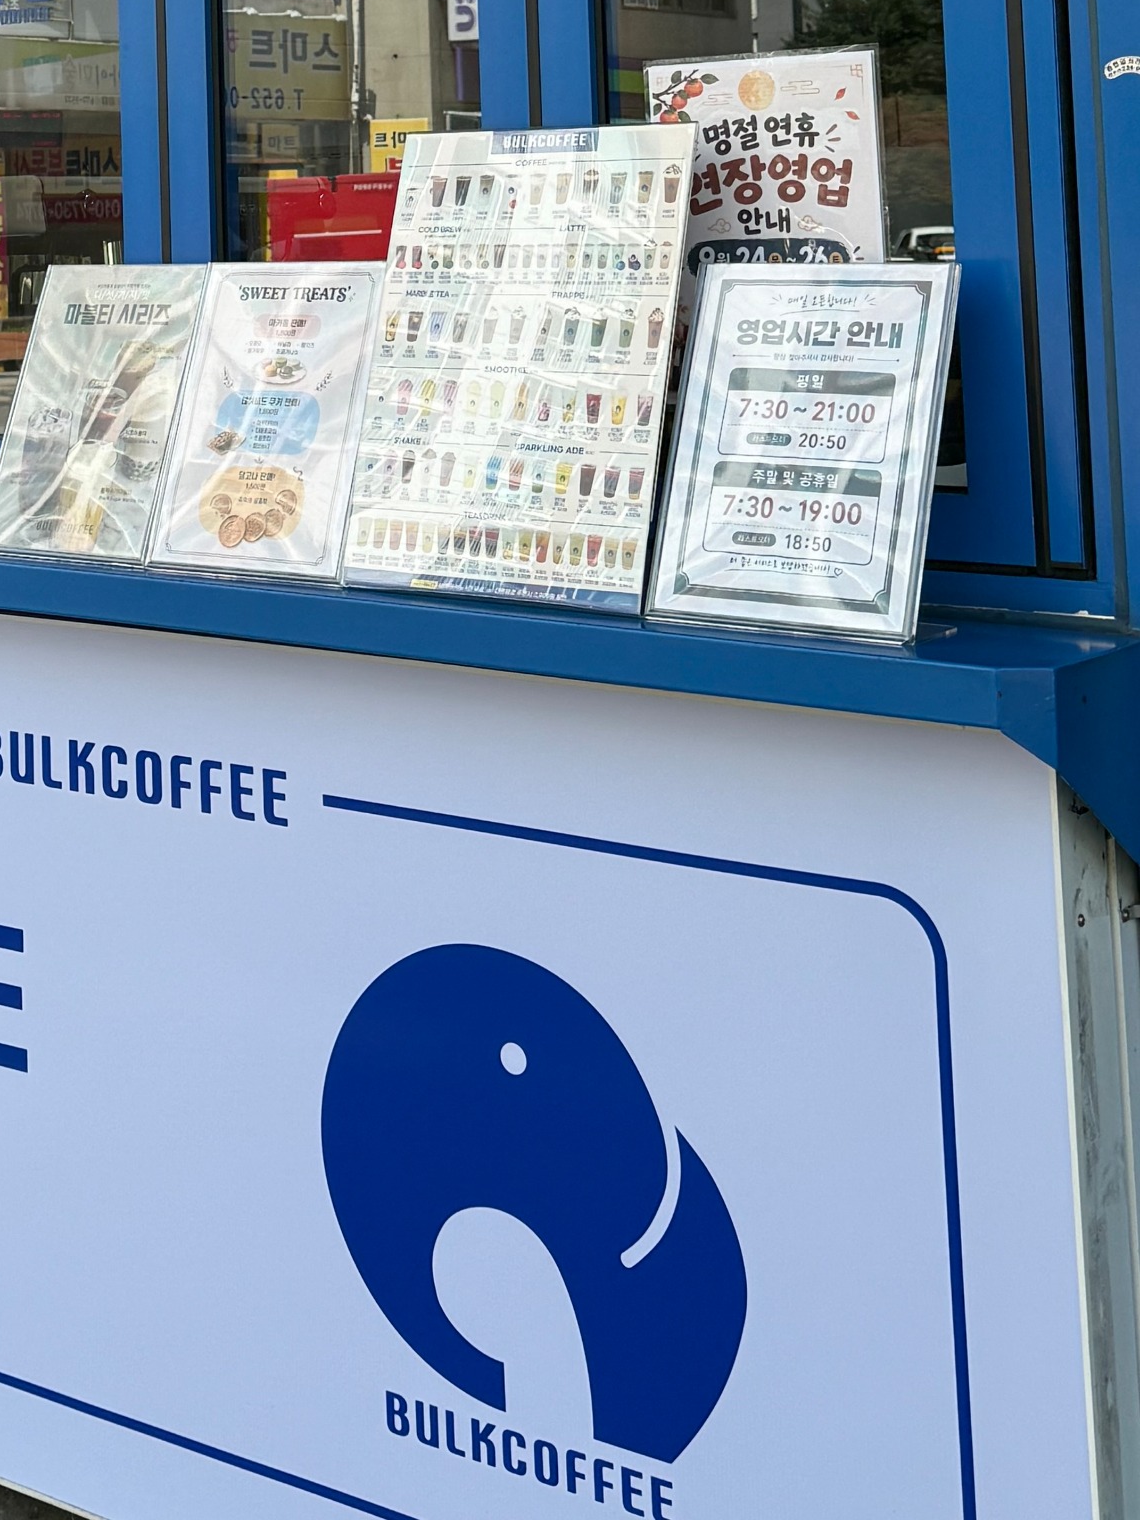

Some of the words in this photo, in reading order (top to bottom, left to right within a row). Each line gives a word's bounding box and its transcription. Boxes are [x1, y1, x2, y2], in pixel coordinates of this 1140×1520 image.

[503, 132, 588, 149] BULKCOFFEE
[702, 114, 759, 156] 명절
[763, 112, 820, 149] 연휴
[515, 158, 548, 167] COFFEE
[689, 153, 853, 216] 연장영업
[559, 224, 587, 233] LATTE
[737, 207, 791, 235] 안내
[64, 303, 116, 326] 마블티
[117, 303, 172, 326] 시리즈
[736, 318, 841, 348] 영업시간
[846, 321, 903, 350] 안내
[796, 374, 825, 389] 평일
[738, 397, 789, 421] 7:30
[812, 400, 876, 424] 21:00
[565, 446, 585, 455] ADE
[798, 433, 847, 450] 20:50
[752, 469, 778, 485] 주말
[782, 470, 795, 486] 및
[799, 472, 839, 489] 공휴일
[723, 494, 774, 519] 7:30
[798, 499, 863, 526] 19:00
[784, 533, 832, 553] 18:50
[384, 1389, 674, 1520] BULKCOFFEE
